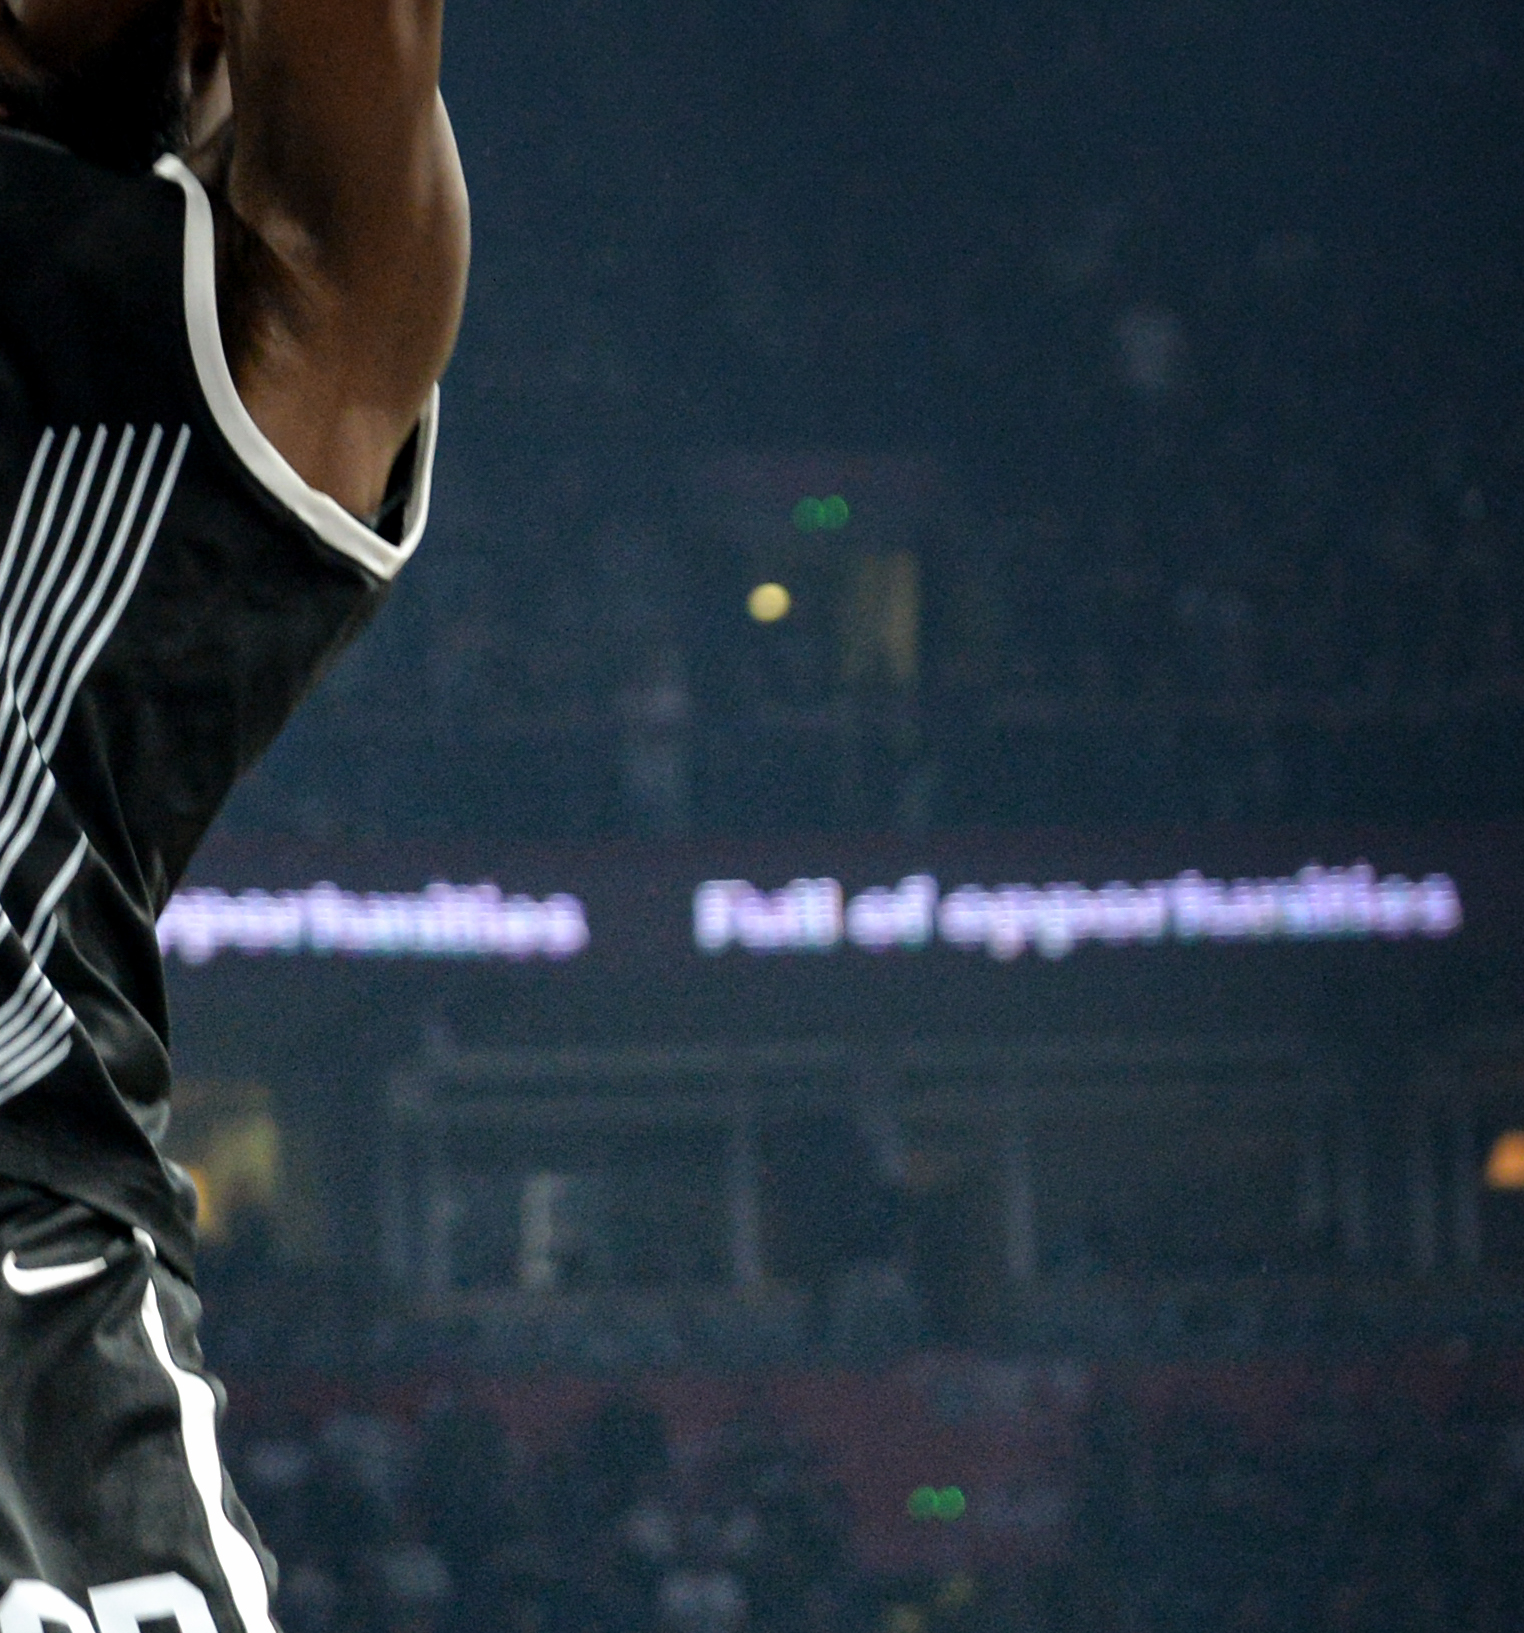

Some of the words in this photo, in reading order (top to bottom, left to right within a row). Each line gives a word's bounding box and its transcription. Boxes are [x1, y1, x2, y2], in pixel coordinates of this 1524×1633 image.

[694, 877, 842, 954] Full
[846, 874, 938, 954] of
[940, 859, 1462, 960] opportunities
